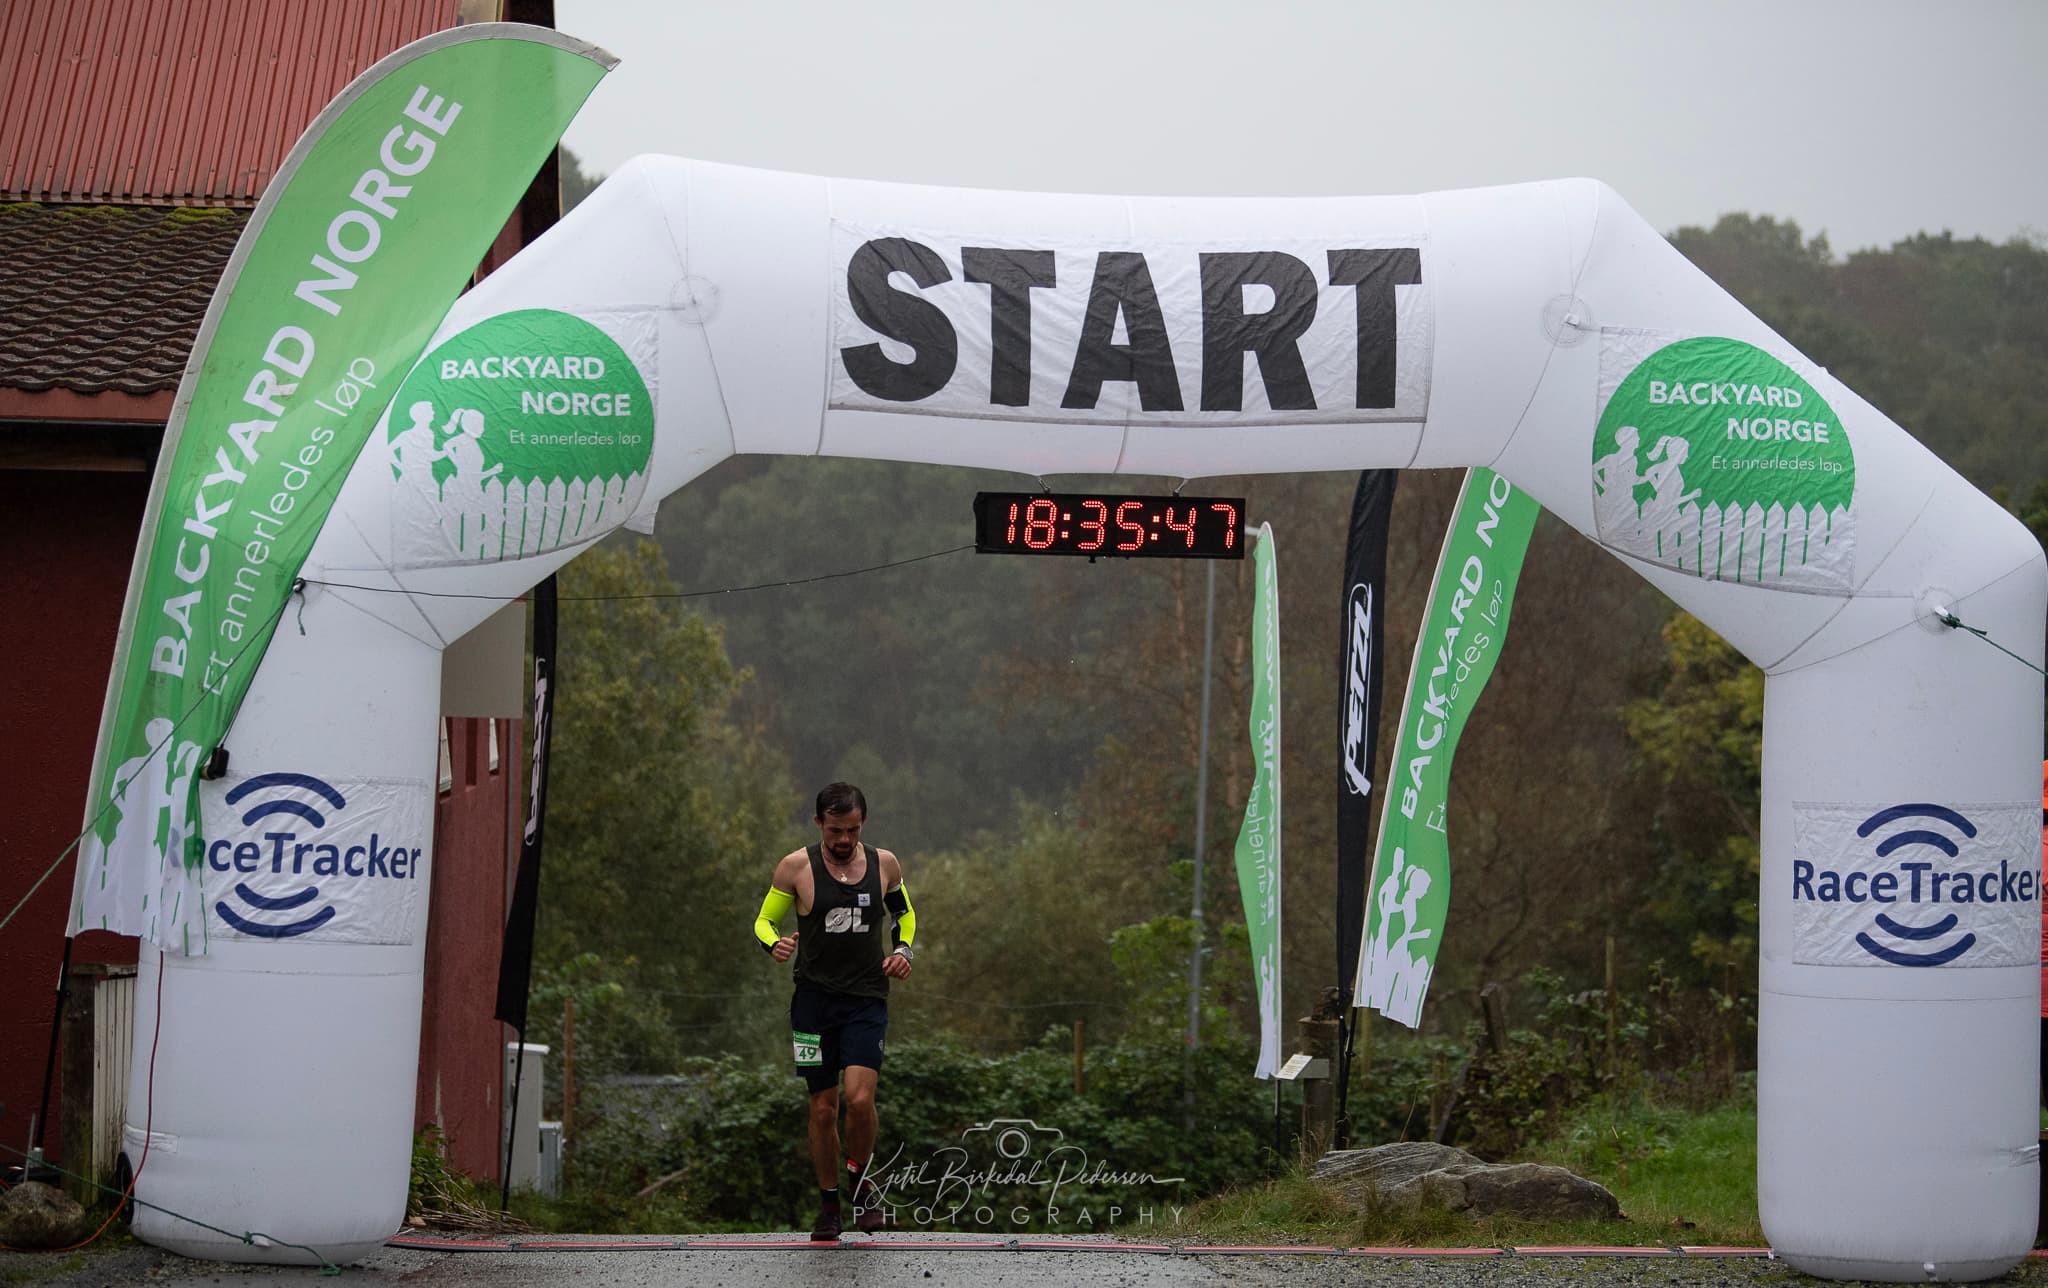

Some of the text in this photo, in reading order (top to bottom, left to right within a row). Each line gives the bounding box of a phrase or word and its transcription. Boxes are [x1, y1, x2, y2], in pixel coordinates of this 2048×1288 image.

[840, 237, 1422, 411] START
[150, 85, 463, 680] BACKYARD NORGE
[440, 356, 605, 380] BACKYARD
[521, 391, 632, 416] NORGE
[1650, 381, 1802, 408] BACKYARD
[509, 430, 641, 450] Et annerledes løp
[1727, 417, 1829, 444] NORGE
[1712, 455, 1842, 474] Et annerledes løp
[203, 357, 376, 697] Et annerledes løp
[1008, 499, 1236, 551] 18:35:47
[1344, 583, 1371, 796] PETZL
[1401, 555, 1483, 820] BACKYARD
[1793, 859, 2041, 904] RaceTracker
[799, 1047, 817, 1060] 49
